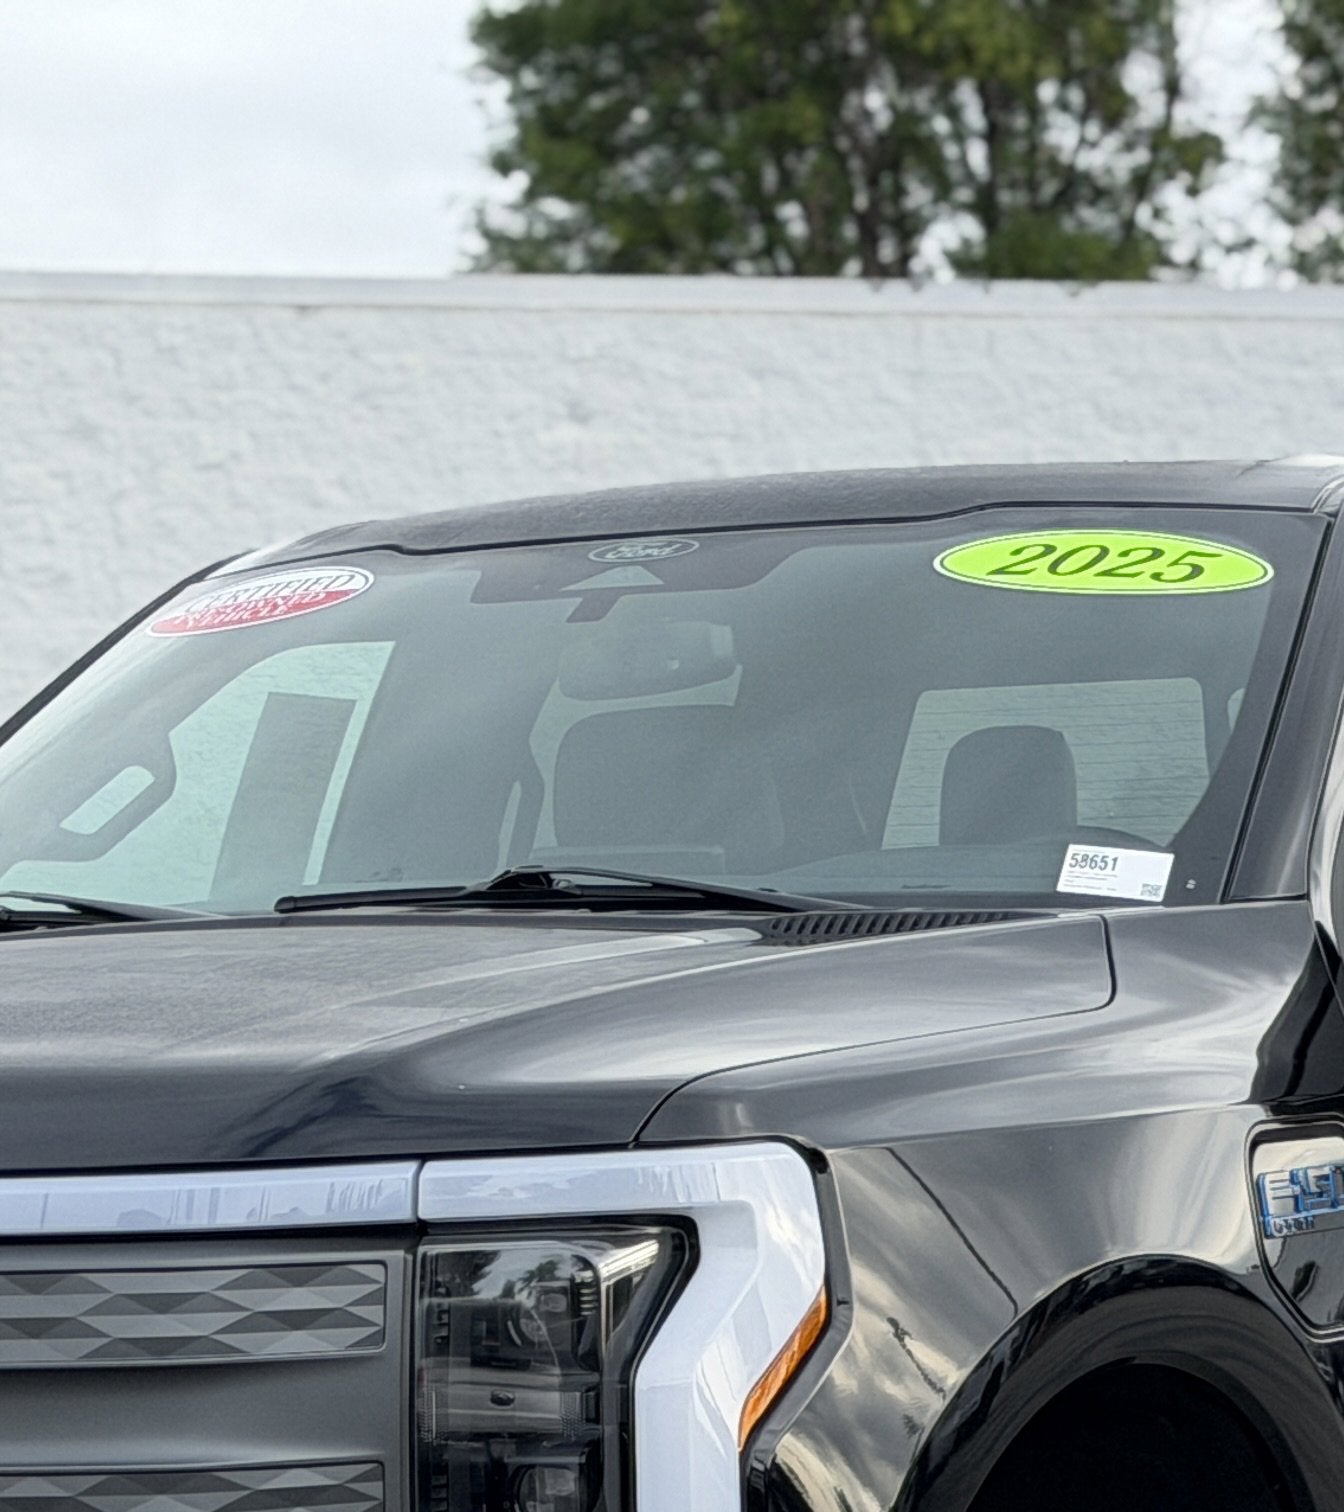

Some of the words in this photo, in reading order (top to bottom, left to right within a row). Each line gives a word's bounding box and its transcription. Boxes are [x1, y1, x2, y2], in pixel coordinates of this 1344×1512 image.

[986, 543, 1223, 584] 2025
[185, 574, 356, 613] CERTIFIED
[1068, 852, 1119, 872] 58651
